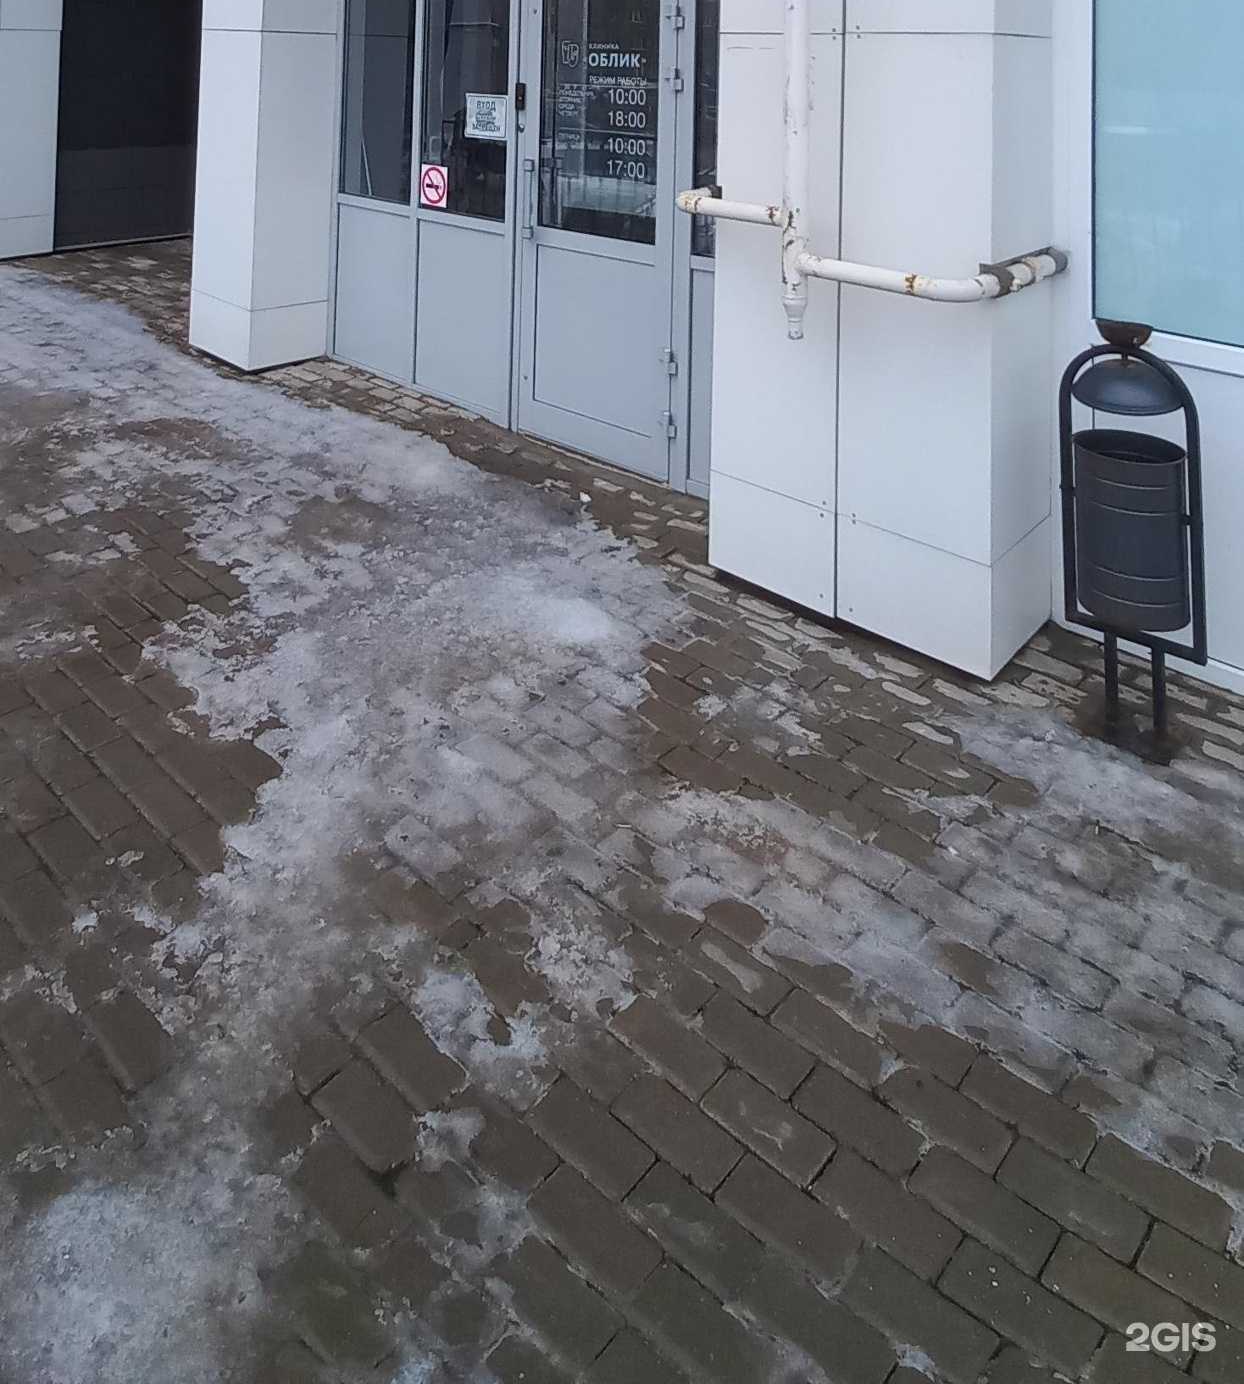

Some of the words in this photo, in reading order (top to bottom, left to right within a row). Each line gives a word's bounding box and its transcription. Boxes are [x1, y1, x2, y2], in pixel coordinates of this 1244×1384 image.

[589, 75, 616, 85] РЕЖИМ
[617, 76, 647, 86] РАБОТЫ
[608, 88, 647, 105] 10:00
[608, 110, 646, 128] 18:00
[607, 137, 646, 155] 10:00
[607, 159, 645, 178] 17:00
